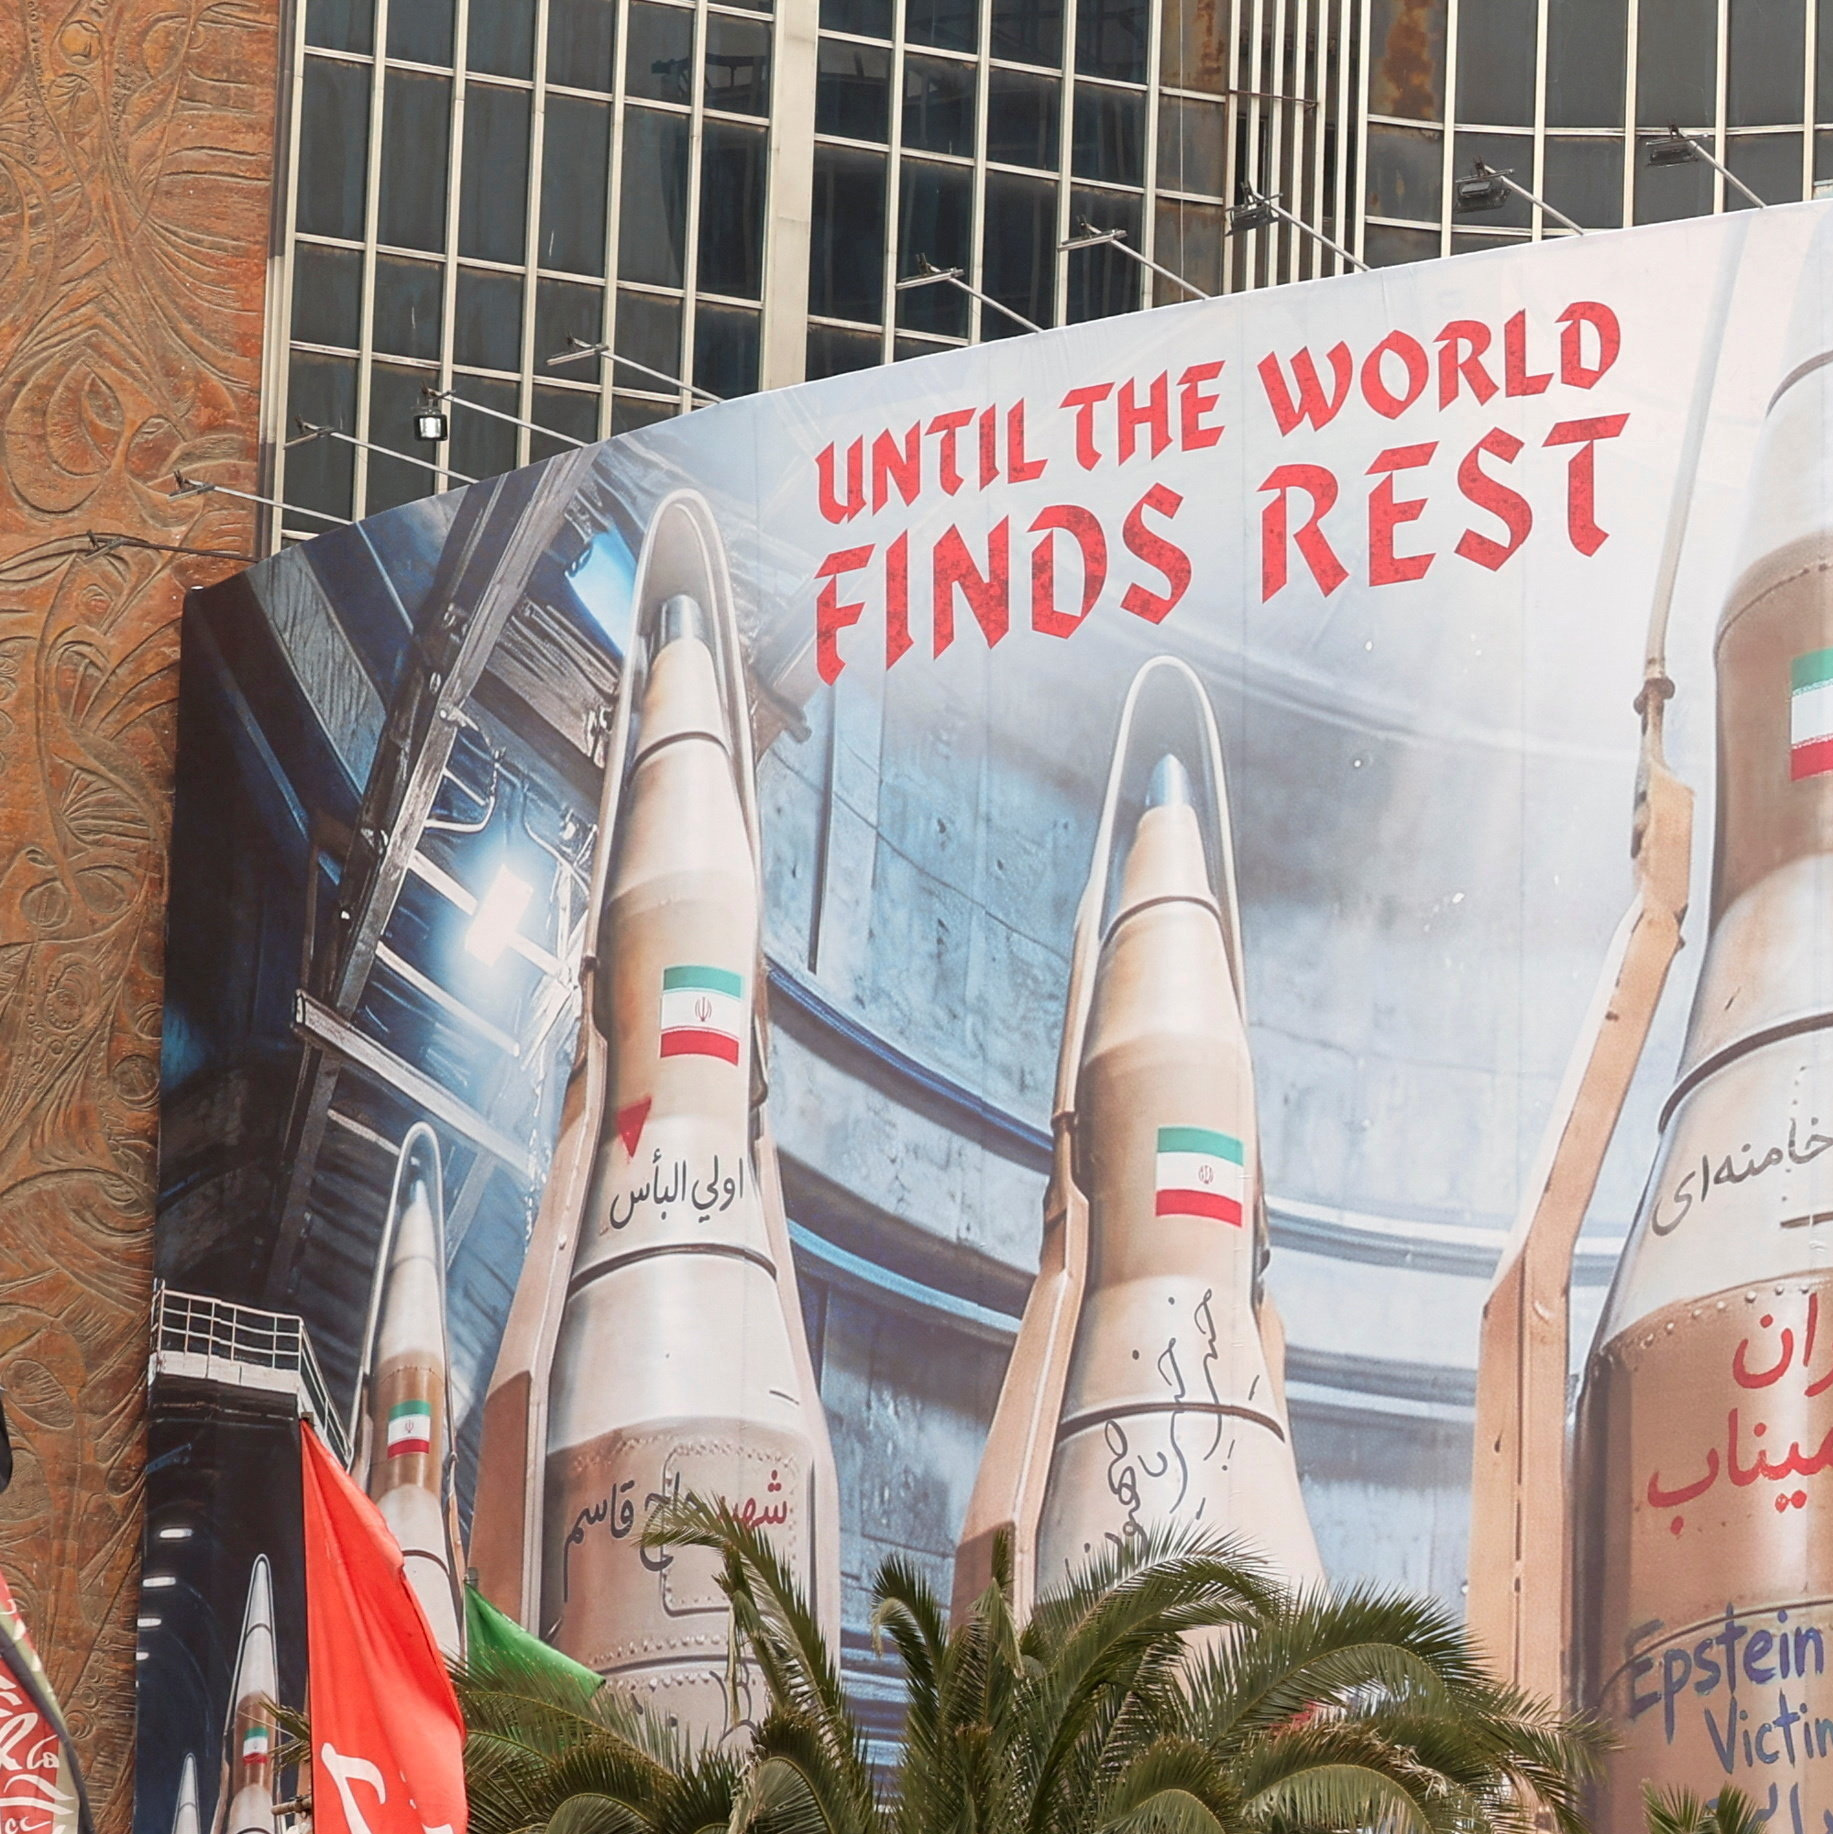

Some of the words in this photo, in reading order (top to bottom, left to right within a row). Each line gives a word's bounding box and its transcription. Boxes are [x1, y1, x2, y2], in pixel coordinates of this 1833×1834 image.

[815, 397, 1050, 526] UNTIL
[1057, 358, 1226, 473] THE
[1257, 299, 1623, 438] WORLD
[813, 482, 1193, 687] FINDS
[1256, 411, 1632, 604] REST
[562, 1478, 638, 1603] قاسم
[1625, 1597, 1826, 1744] Epstein
